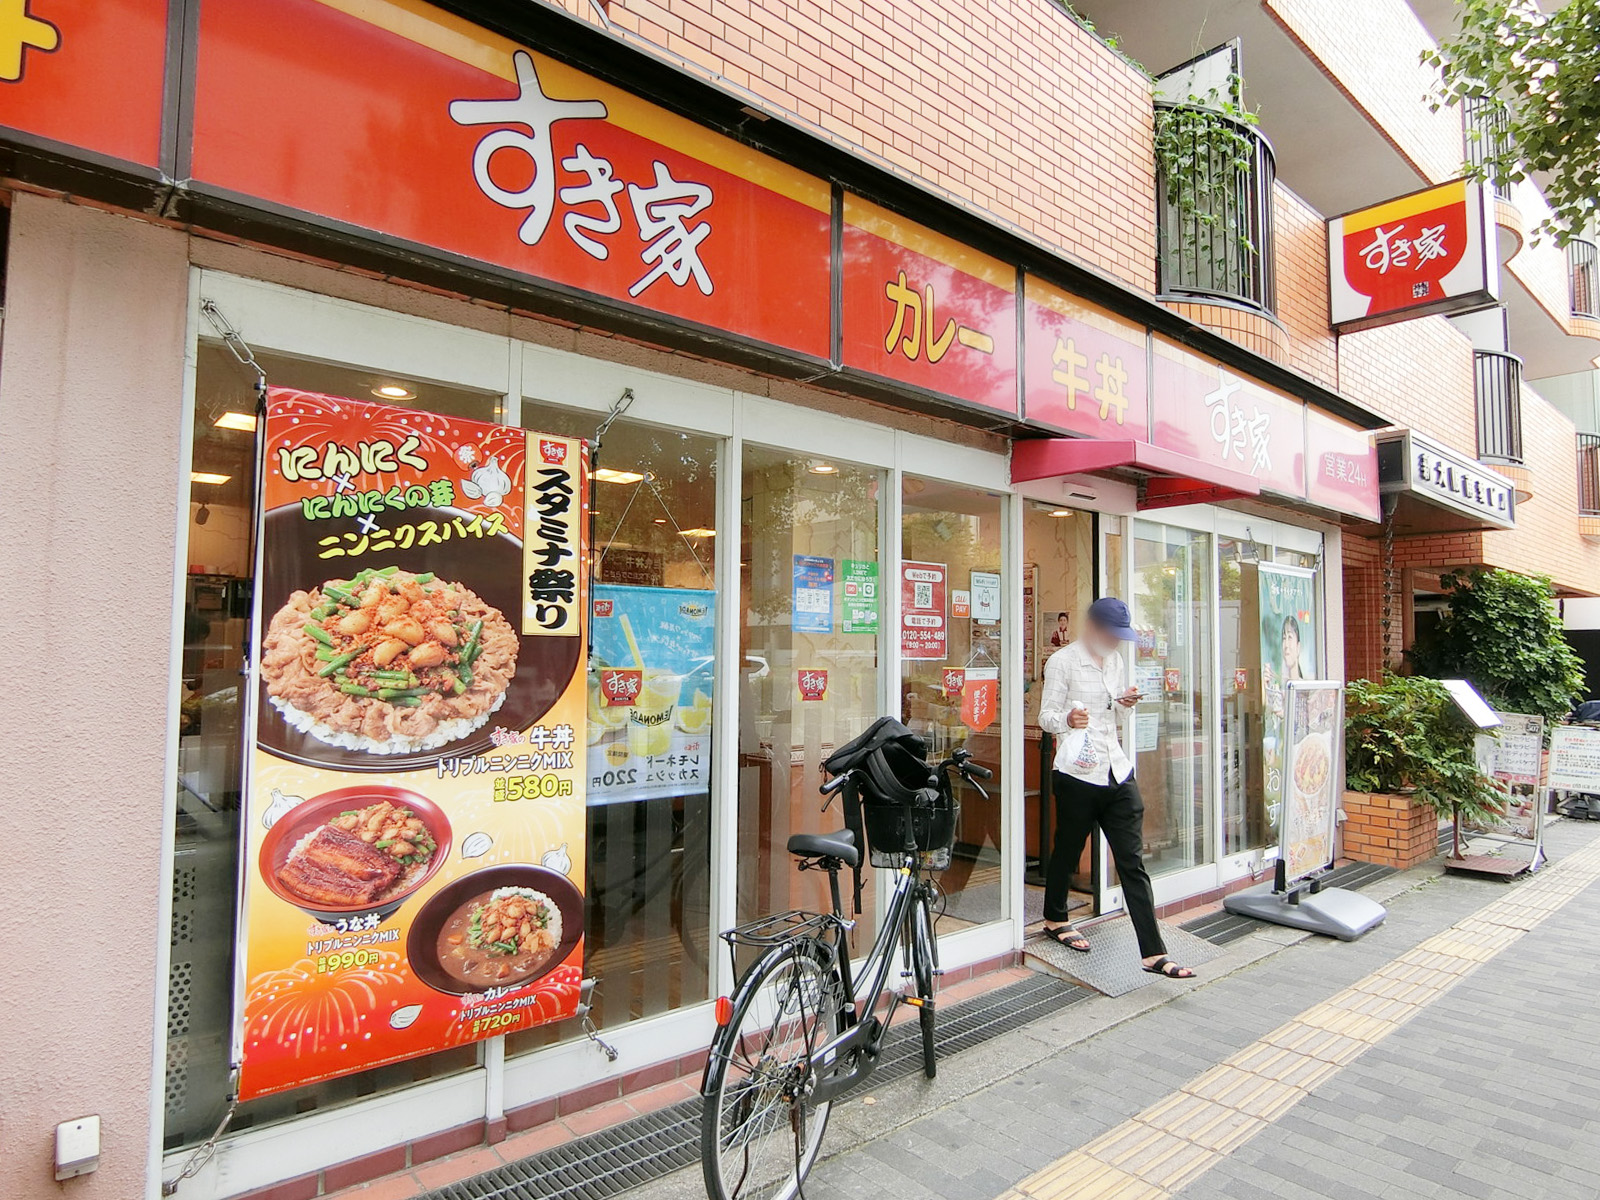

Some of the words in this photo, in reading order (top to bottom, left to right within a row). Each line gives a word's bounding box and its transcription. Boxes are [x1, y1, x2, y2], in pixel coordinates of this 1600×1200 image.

[449, 50, 714, 298] すき家
[1359, 223, 1448, 274] すき家
[886, 270, 995, 364] カレー
[1051, 337, 1130, 425] 牛丼
[1204, 364, 1273, 477] すき家
[278, 434, 428, 482] にんにく
[1324, 452, 1367, 486] 営業24H
[301, 479, 456, 521] にんにくの芽
[317, 512, 510, 560] ニンニクスパイス
[529, 467, 576, 630] スタミナ祭り
[605, 670, 639, 697] すき家
[801, 671, 825, 693] すき家
[530, 724, 575, 750] 牛丼
[437, 750, 574, 779] トリプルニンニクMIX
[506, 773, 572, 801] 580円
[336, 912, 382, 935] うな丼
[307, 929, 401, 957] トリプルニンニクMIX
[327, 949, 379, 972] 990円
[459, 994, 537, 1022] トリプルニンニクMIX
[484, 985, 522, 1002] カレー
[481, 1012, 521, 1031] 720円
